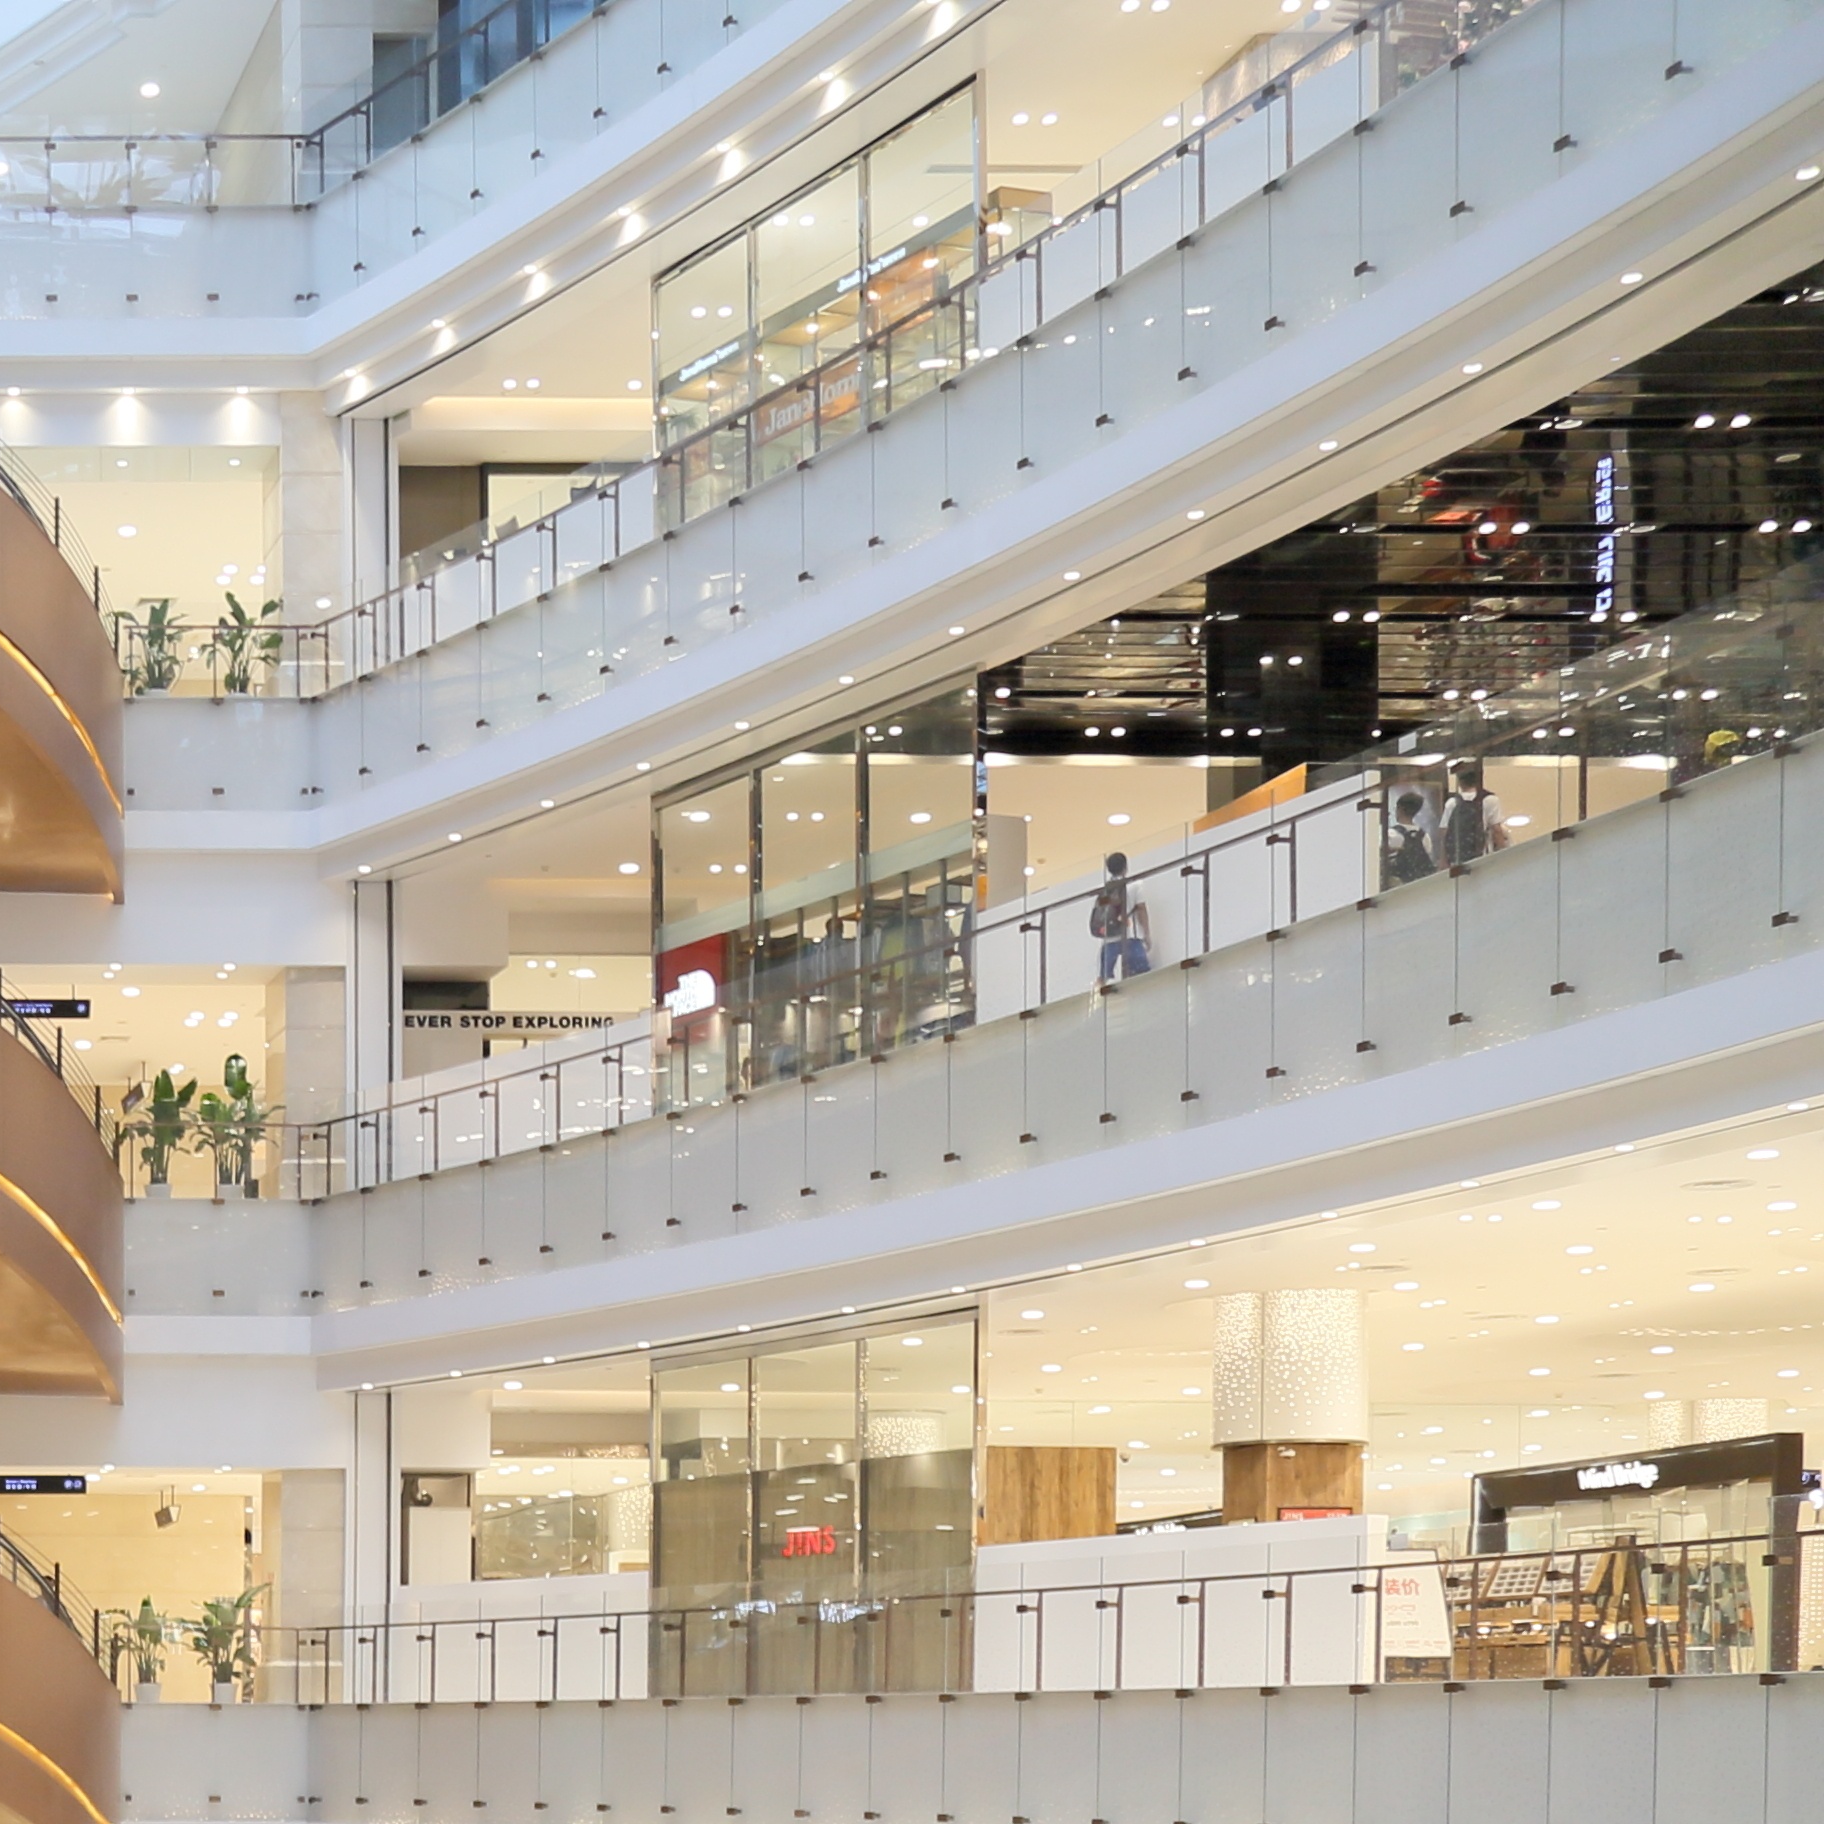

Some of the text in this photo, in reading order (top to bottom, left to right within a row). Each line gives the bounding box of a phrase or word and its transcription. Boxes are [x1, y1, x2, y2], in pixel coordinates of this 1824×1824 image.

[404, 1015, 614, 1029] EVER STOP EXPLORING
[781, 1525, 836, 1557] JINS
